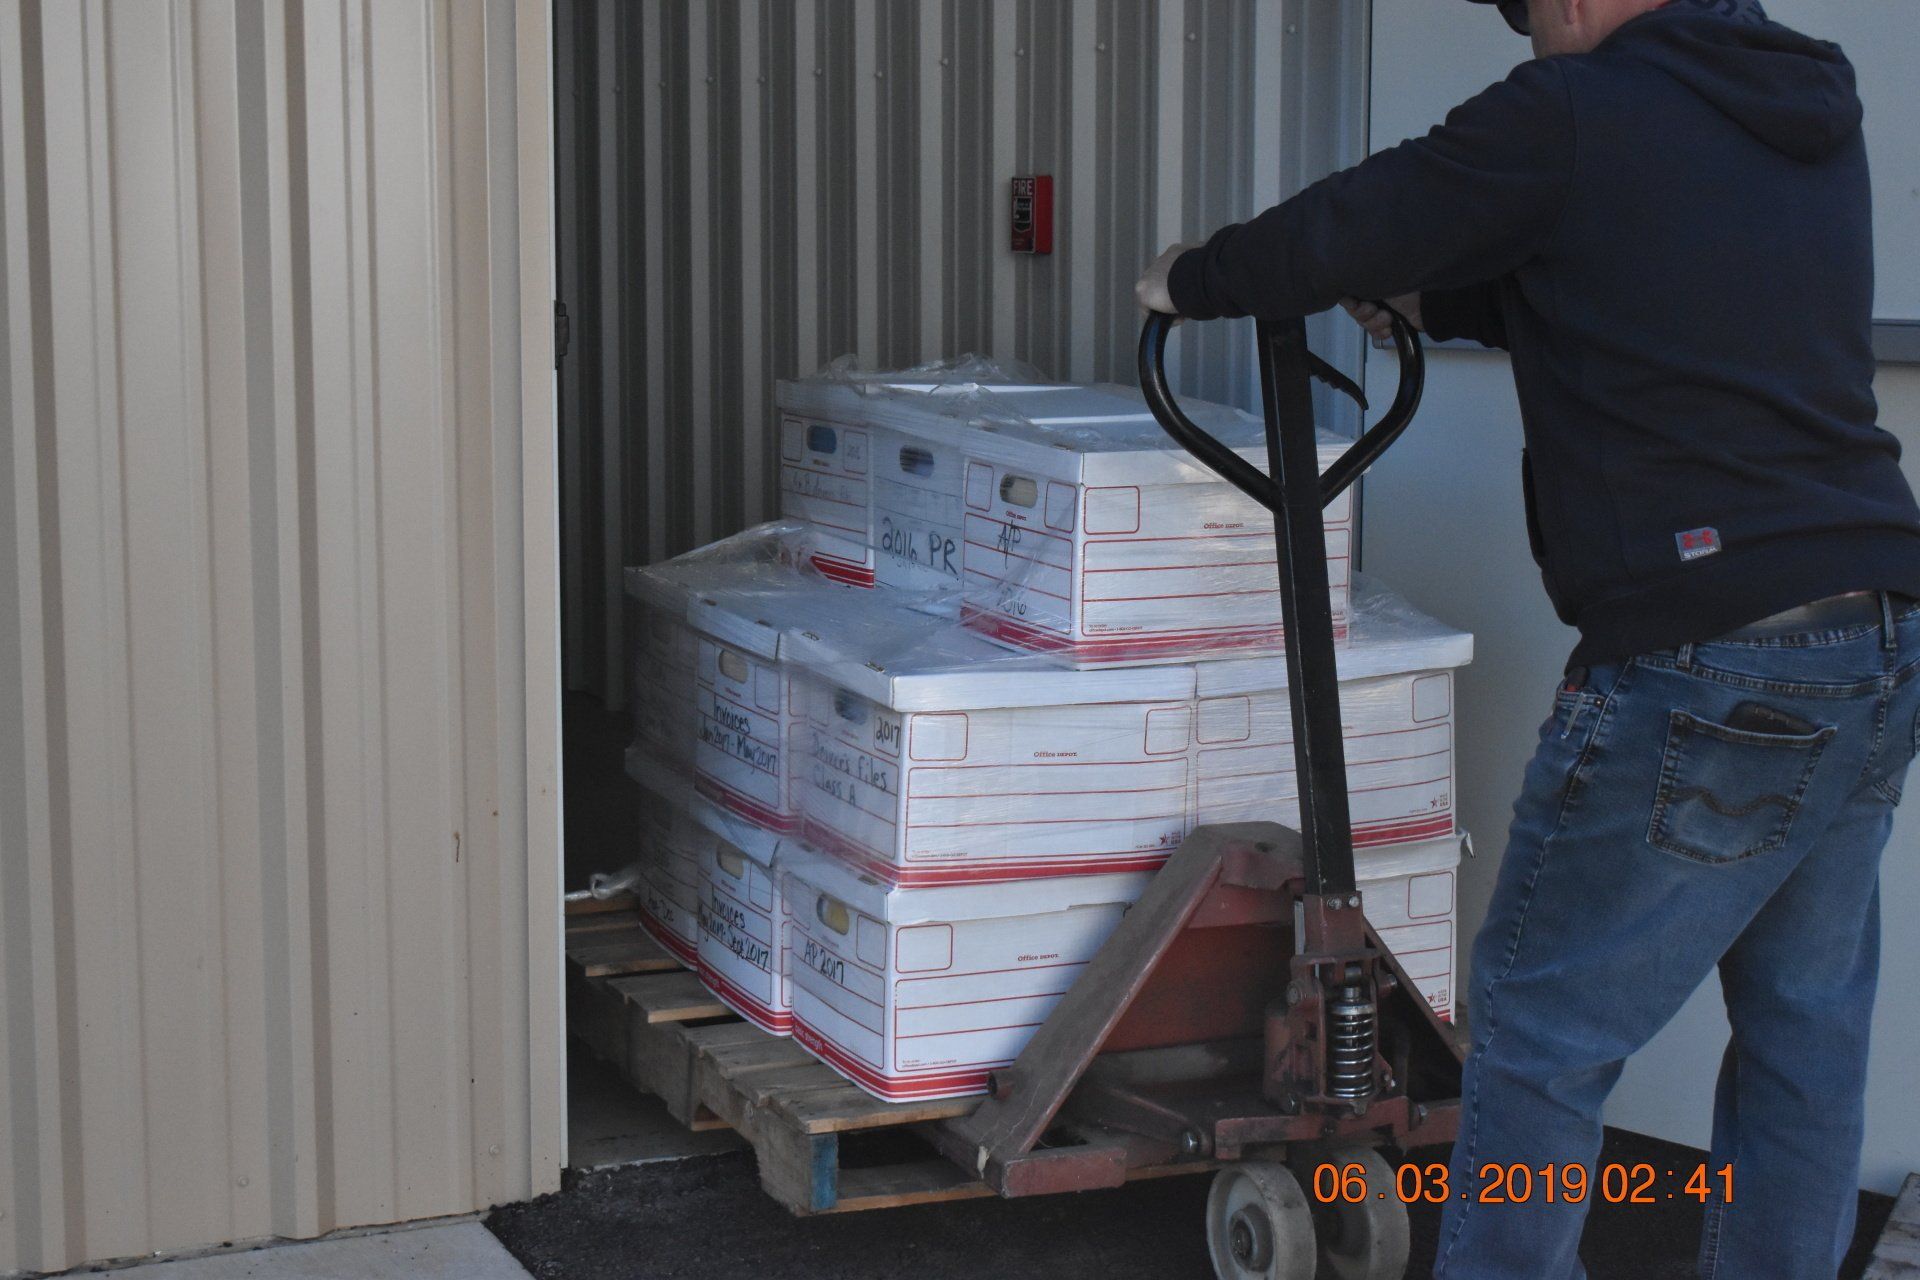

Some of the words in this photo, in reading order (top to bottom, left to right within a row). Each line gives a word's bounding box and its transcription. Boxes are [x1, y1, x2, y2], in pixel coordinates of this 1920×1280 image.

[1013, 180, 1033, 196] FIRE
[1203, 522, 1225, 530] Office
[882, 516, 918, 564] 2016
[929, 531, 959, 581] PR
[1683, 545, 1718, 559] STORM
[713, 694, 750, 735] Invoices
[875, 716, 900, 749] 2017
[1033, 751, 1056, 760] Office
[812, 764, 842, 799] Class
[848, 783, 856, 807] A
[711, 885, 746, 929] Invoices
[803, 940, 818, 967] AP
[819, 948, 845, 985] 2017
[1017, 953, 1039, 962] Office
